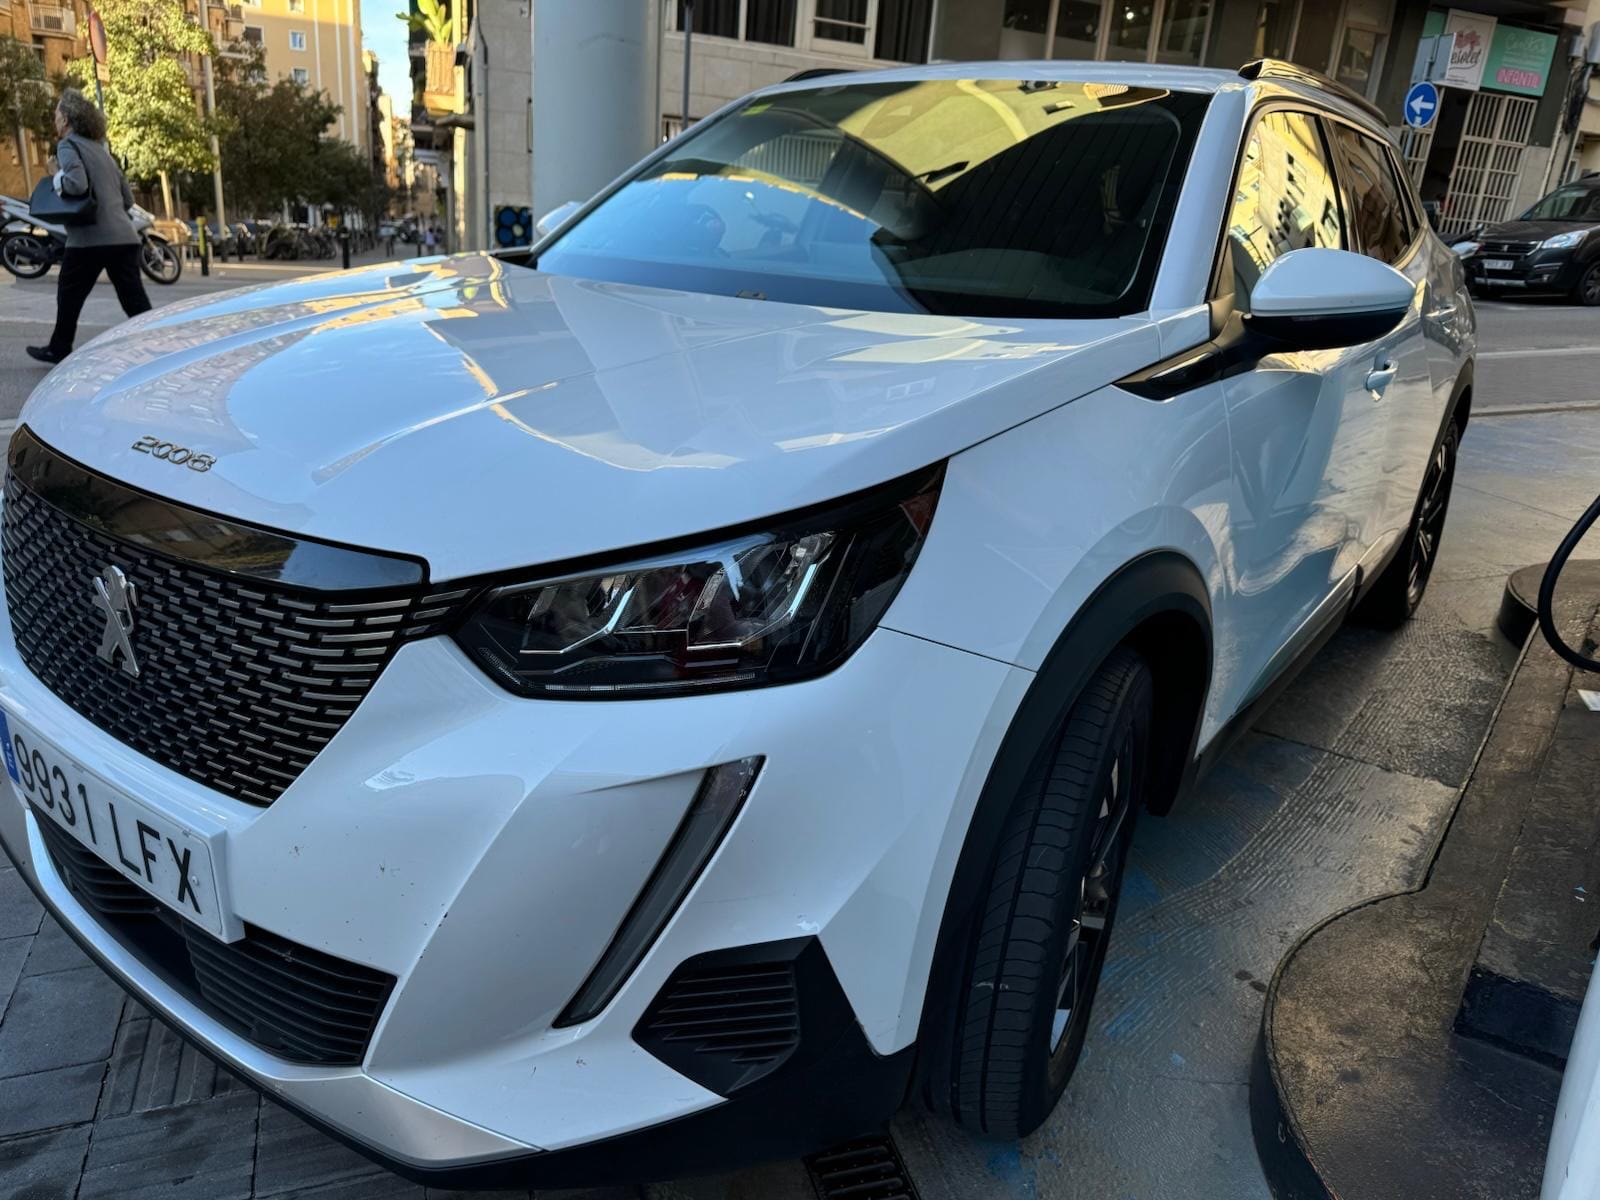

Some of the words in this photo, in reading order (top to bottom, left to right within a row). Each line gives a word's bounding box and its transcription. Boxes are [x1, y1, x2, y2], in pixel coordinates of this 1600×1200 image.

[1450, 48, 1482, 66] esolet
[131, 435, 217, 473] 2008
[14, 733, 97, 845] 9931
[109, 802, 202, 915] LFX
